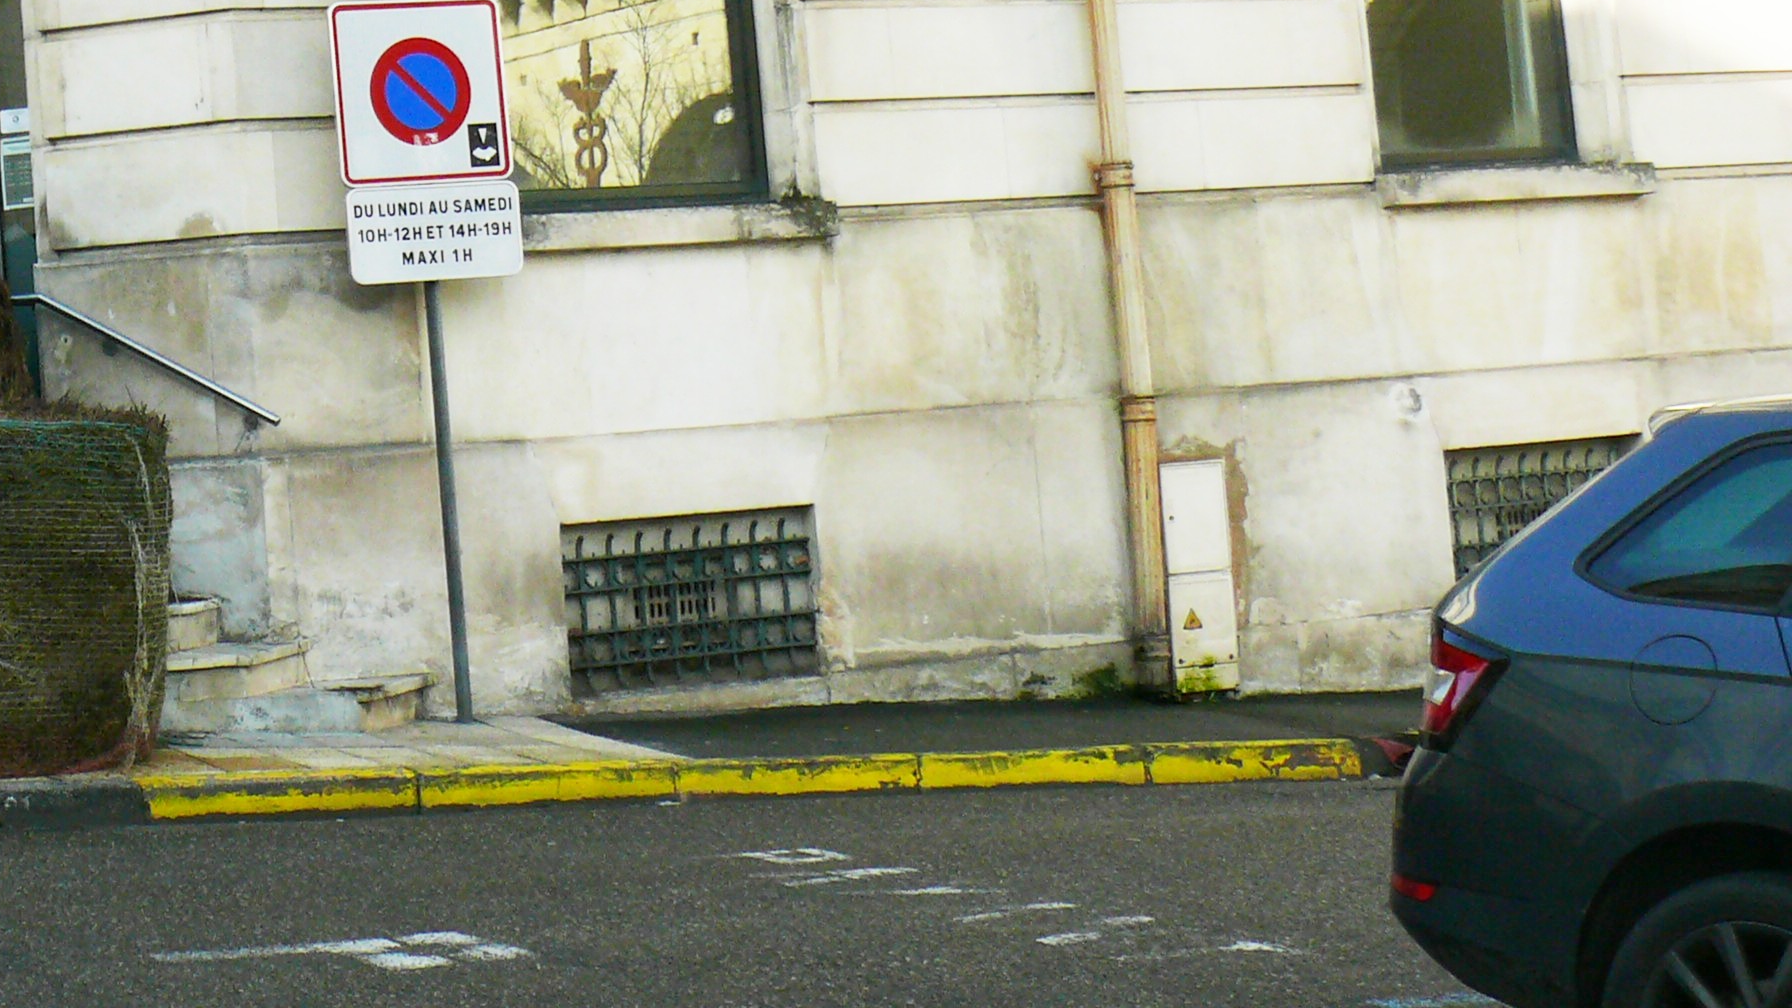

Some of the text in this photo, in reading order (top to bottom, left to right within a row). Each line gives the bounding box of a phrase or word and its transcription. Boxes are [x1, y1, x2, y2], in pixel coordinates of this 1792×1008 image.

[353, 197, 512, 219] DU LUNDI AU SAMEDI
[358, 221, 512, 243] 10H-12H ET 14H-19H
[402, 248, 473, 265] MAXI 1H
